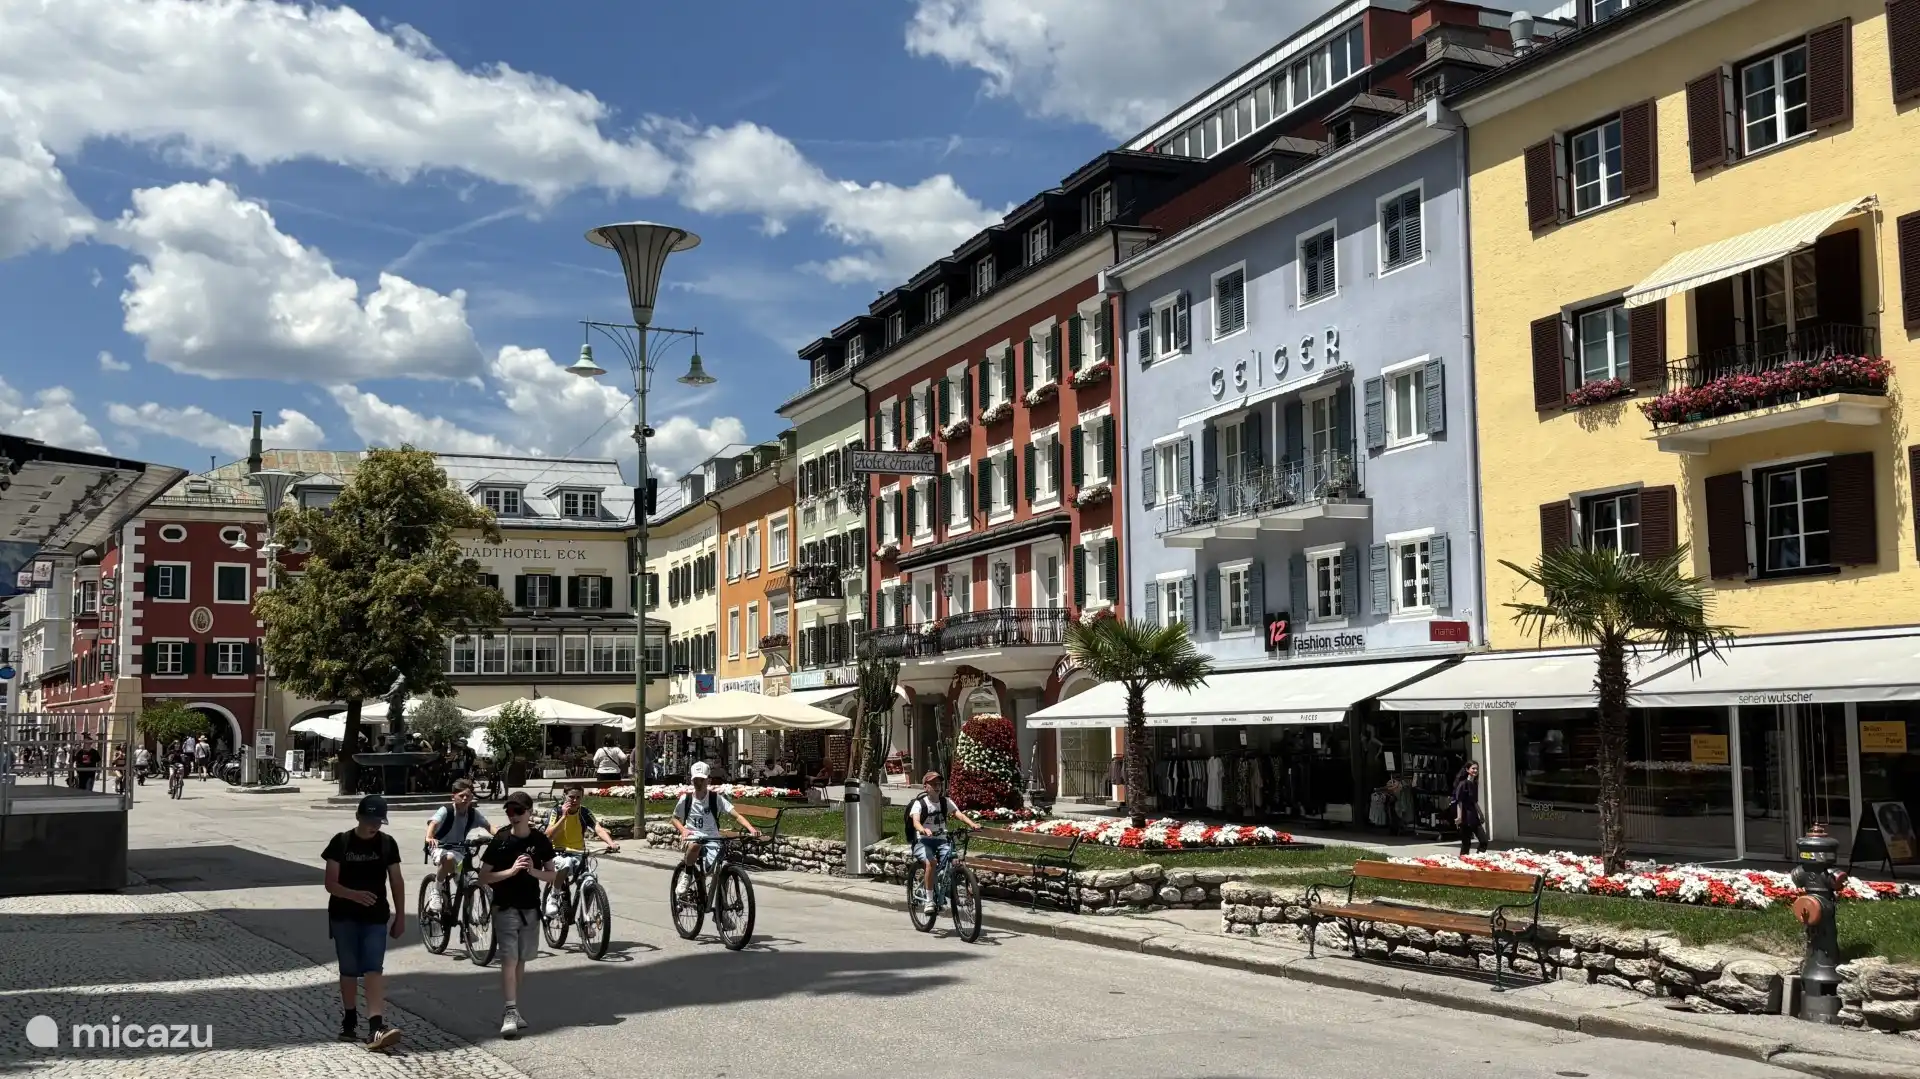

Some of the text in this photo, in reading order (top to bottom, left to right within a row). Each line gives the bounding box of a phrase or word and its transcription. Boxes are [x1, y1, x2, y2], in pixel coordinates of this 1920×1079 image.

[1210, 325, 1340, 401] GEIGER
[855, 453, 888, 470] Hotel
[557, 549, 587, 560] ECK
[101, 578, 114, 672] SCHUHE
[1269, 620, 1288, 647] 12
[1293, 635, 1331, 650] fashion
[1485, 700, 1518, 709] wutscher
[1767, 691, 1813, 703] wutscher
[693, 817, 704, 829] 19
